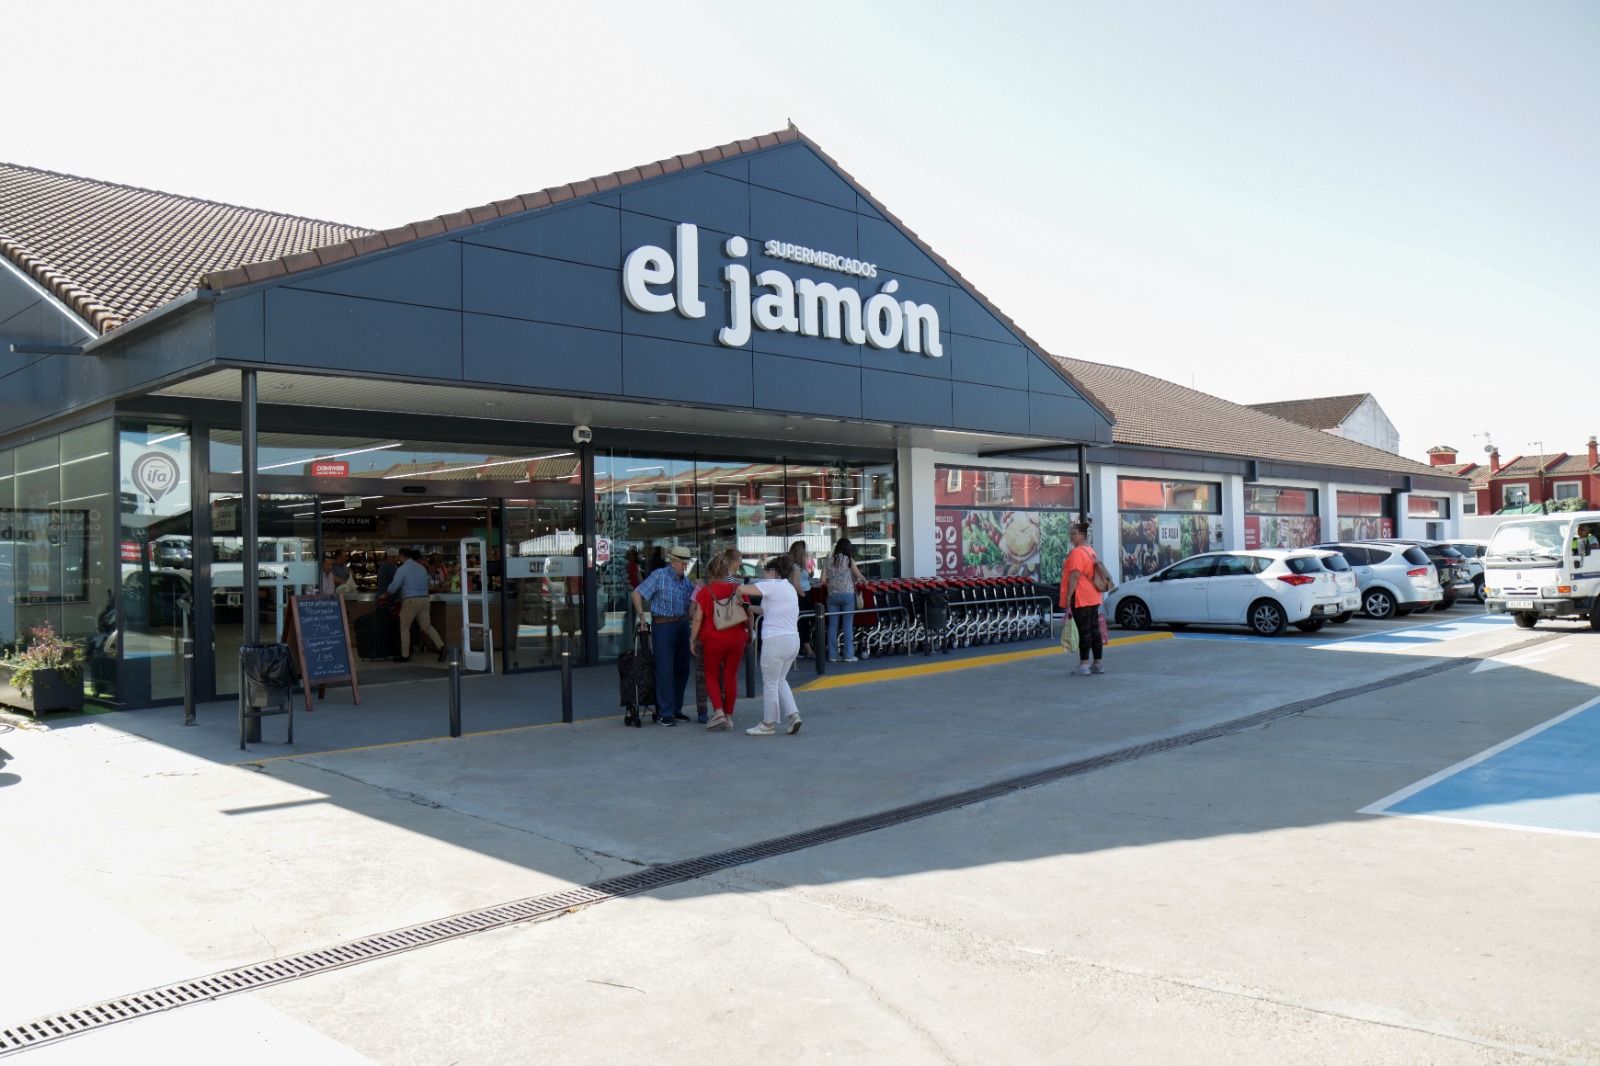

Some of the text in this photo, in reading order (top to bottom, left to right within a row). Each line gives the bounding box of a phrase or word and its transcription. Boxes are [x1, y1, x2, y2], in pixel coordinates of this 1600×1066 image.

[765, 239, 877, 278] SUPERMERCADOS
[623, 223, 943, 357] el jamón
[147, 469, 167, 484] ifa
